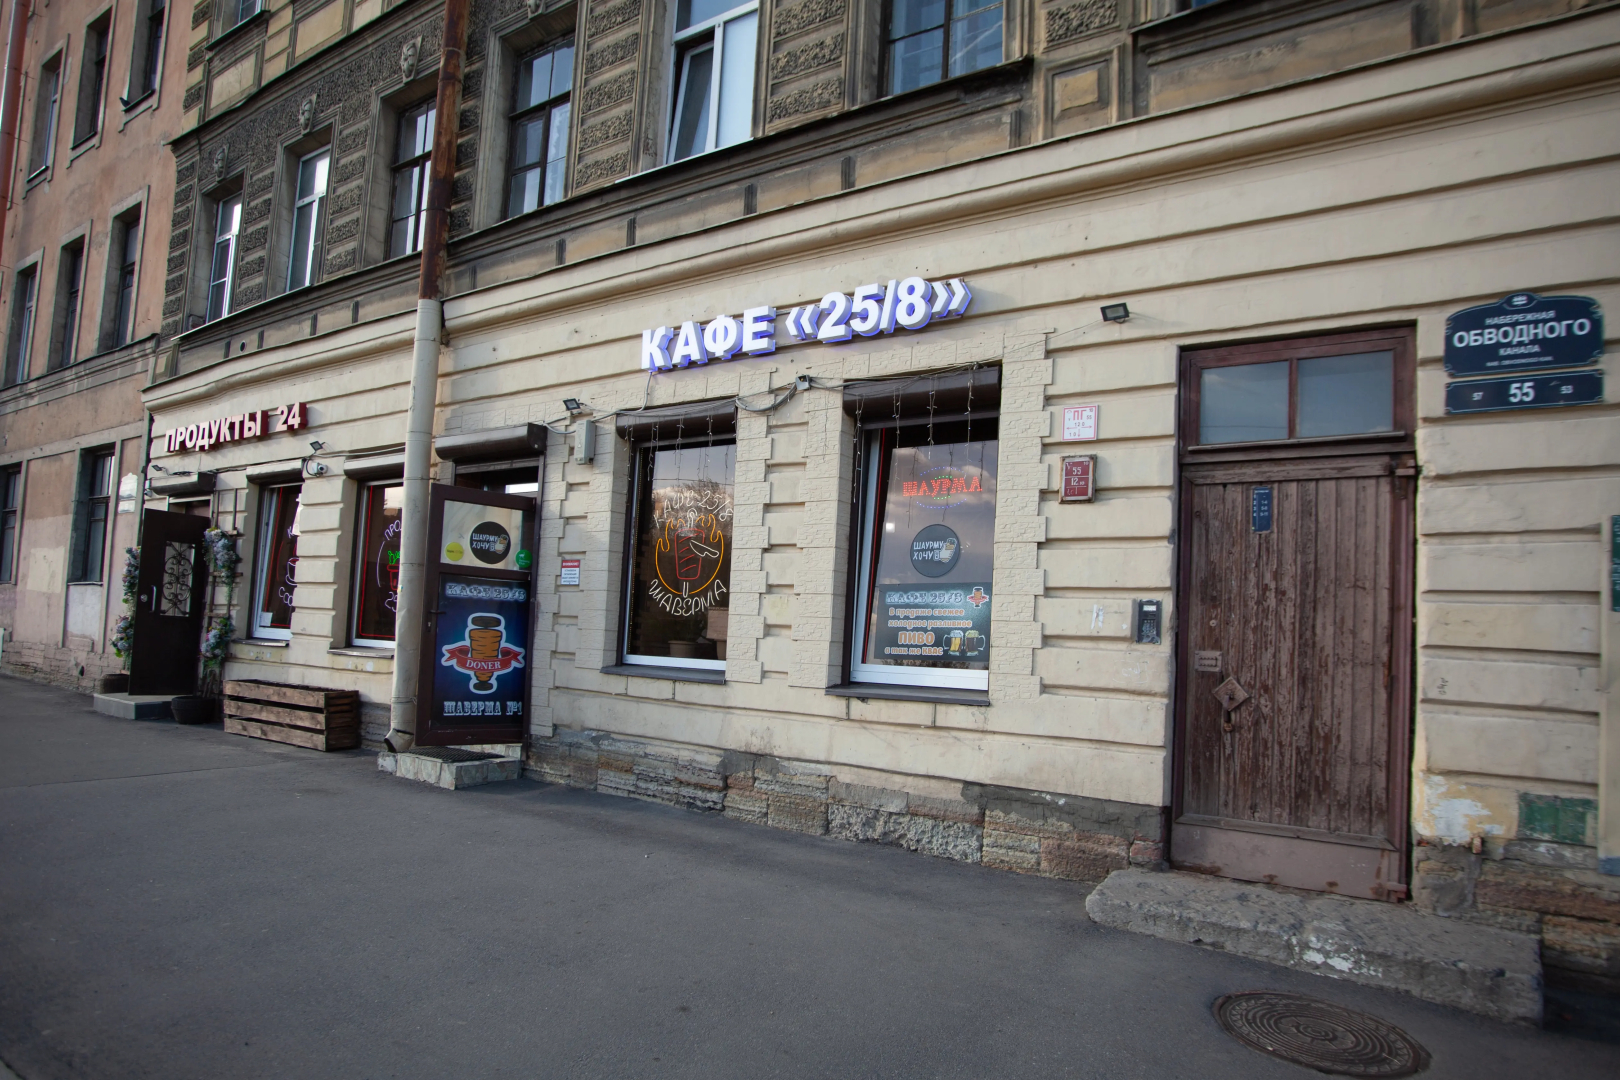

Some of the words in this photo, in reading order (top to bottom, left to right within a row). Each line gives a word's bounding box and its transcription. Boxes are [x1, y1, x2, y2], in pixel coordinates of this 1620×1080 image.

[640, 305, 776, 372] КАФЕ
[785, 276, 973, 343] «25/8»
[1485, 310, 1556, 326] НАБЕРЕЖНАЯ
[1453, 318, 1591, 347] ОБВОДНОГО
[1498, 344, 1541, 356] КАНАЛА
[1509, 382, 1535, 402] 55
[164, 410, 266, 452] ПРОДУКТЫ
[276, 402, 305, 432] 24
[902, 476, 983, 497] ШАУРМА
[697, 490, 734, 521] 25/8
[472, 532, 499, 544] ШАУРМУ
[913, 540, 944, 550] ШАУРМУ
[472, 541, 490, 551] ХОЧУ
[912, 550, 934, 561] ХОЧУ
[446, 583, 491, 599] КАФЕ
[649, 579, 727, 616] ШАВЕРМА
[886, 591, 927, 604] КАФЕ
[889, 607, 895, 616] В
[896, 608, 932, 618] продаже
[933, 608, 964, 616] свежее
[888, 620, 927, 629] холодное
[928, 620, 972, 630] разливное
[898, 631, 935, 645] ПИВО
[891, 647, 909, 655] так
[922, 647, 943, 655] КВАС
[466, 659, 502, 670] DONER
[443, 701, 501, 716] ШАВЕРМА
